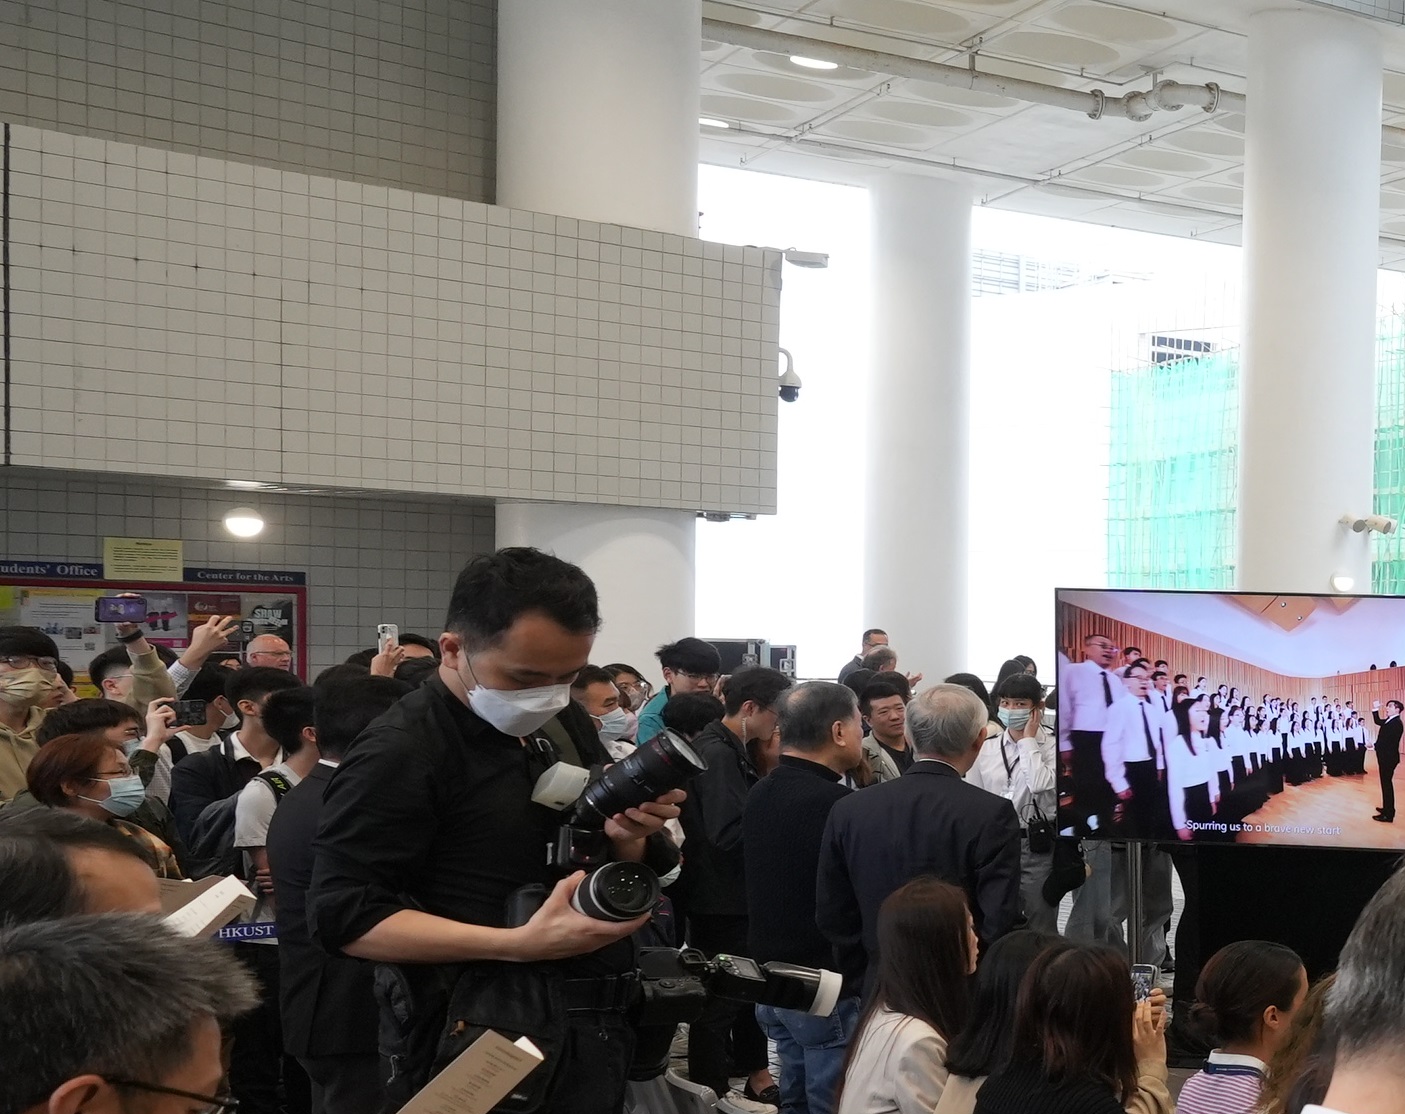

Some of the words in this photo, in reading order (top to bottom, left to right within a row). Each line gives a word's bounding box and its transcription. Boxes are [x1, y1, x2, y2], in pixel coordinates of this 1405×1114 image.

[56, 564, 98, 576] Office
[197, 570, 233, 581] Center
[235, 571, 251, 581] for
[253, 573, 271, 582] the
[271, 573, 294, 583] Arts
[254, 608, 282, 619] SHAW
[1186, 820, 1227, 833] Spurring
[1229, 823, 1241, 832] us
[1242, 823, 1253, 832] to
[1264, 824, 1292, 833] brave
[1294, 826, 1315, 834] new
[1317, 826, 1342, 835] start
[218, 924, 275, 939] HKUST
